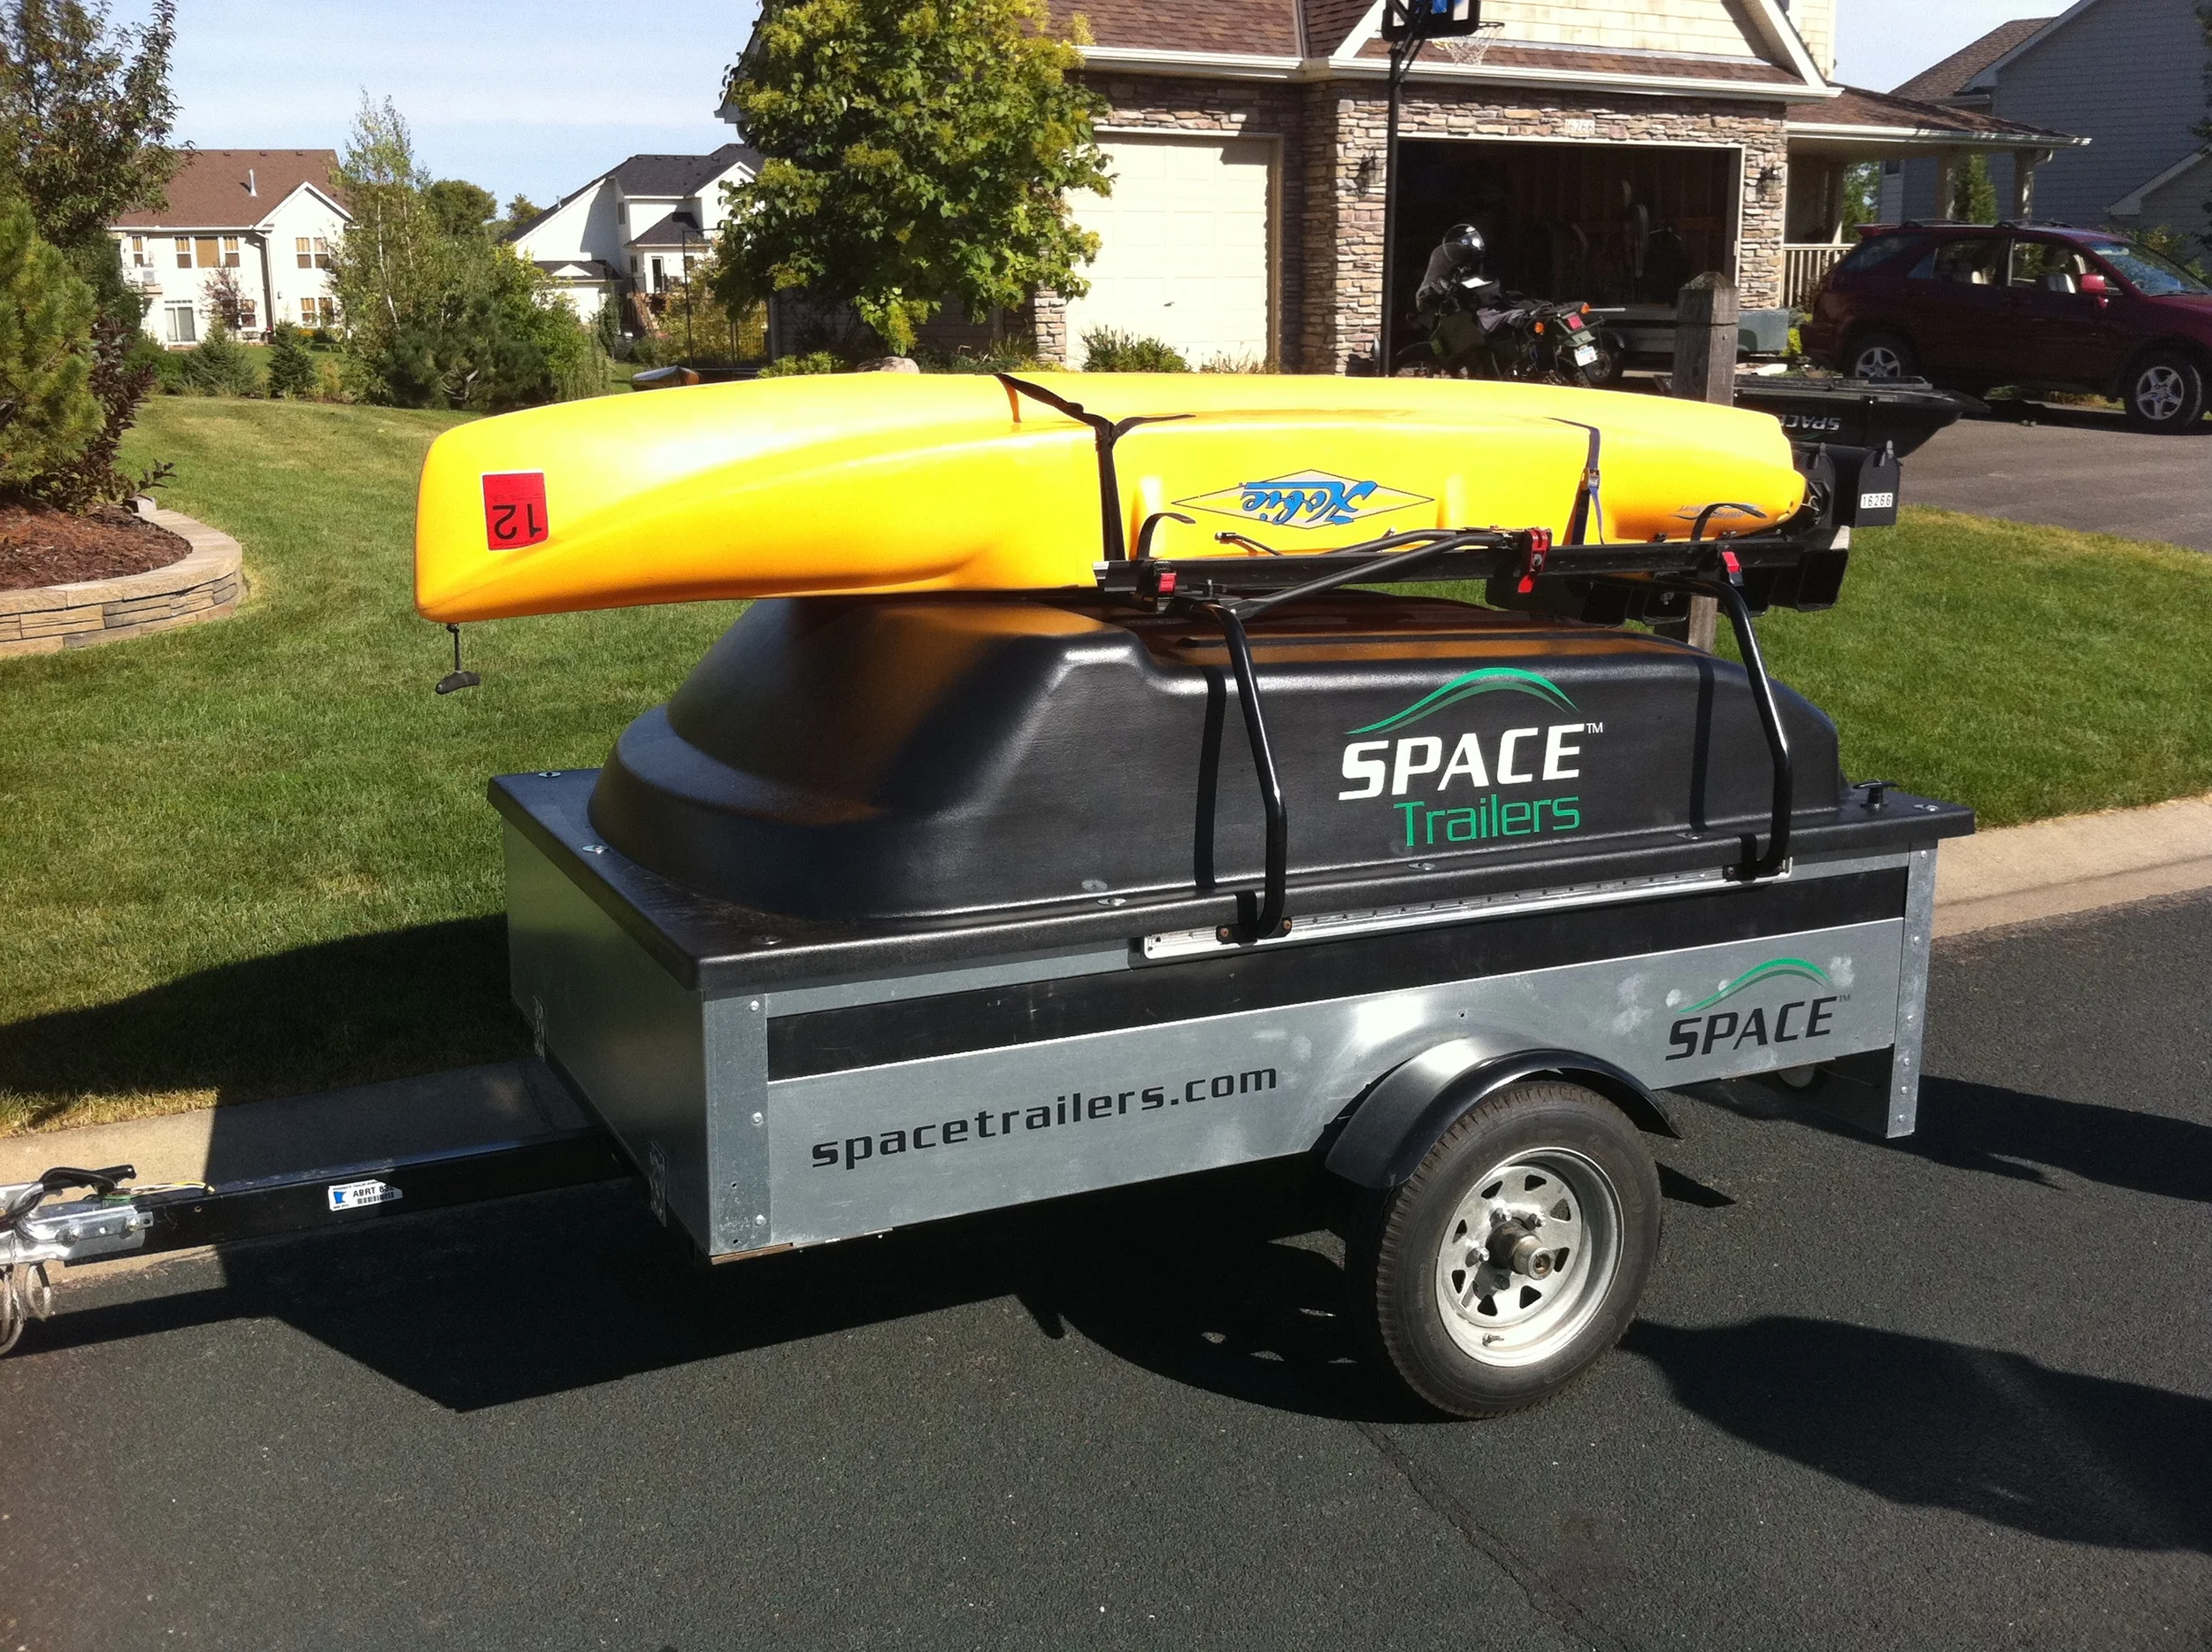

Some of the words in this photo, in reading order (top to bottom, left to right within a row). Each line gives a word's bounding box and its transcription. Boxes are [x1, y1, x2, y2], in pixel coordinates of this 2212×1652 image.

[492, 503, 542, 540] 12
[1240, 480, 1378, 525] Hobie
[1863, 495, 1892, 507] 16266
[1338, 723, 1585, 801] SPACE
[1394, 794, 1580, 847] Trailers
[1665, 995, 1838, 1061] SPACE
[811, 1067, 1277, 1170] spacetrailers.com
